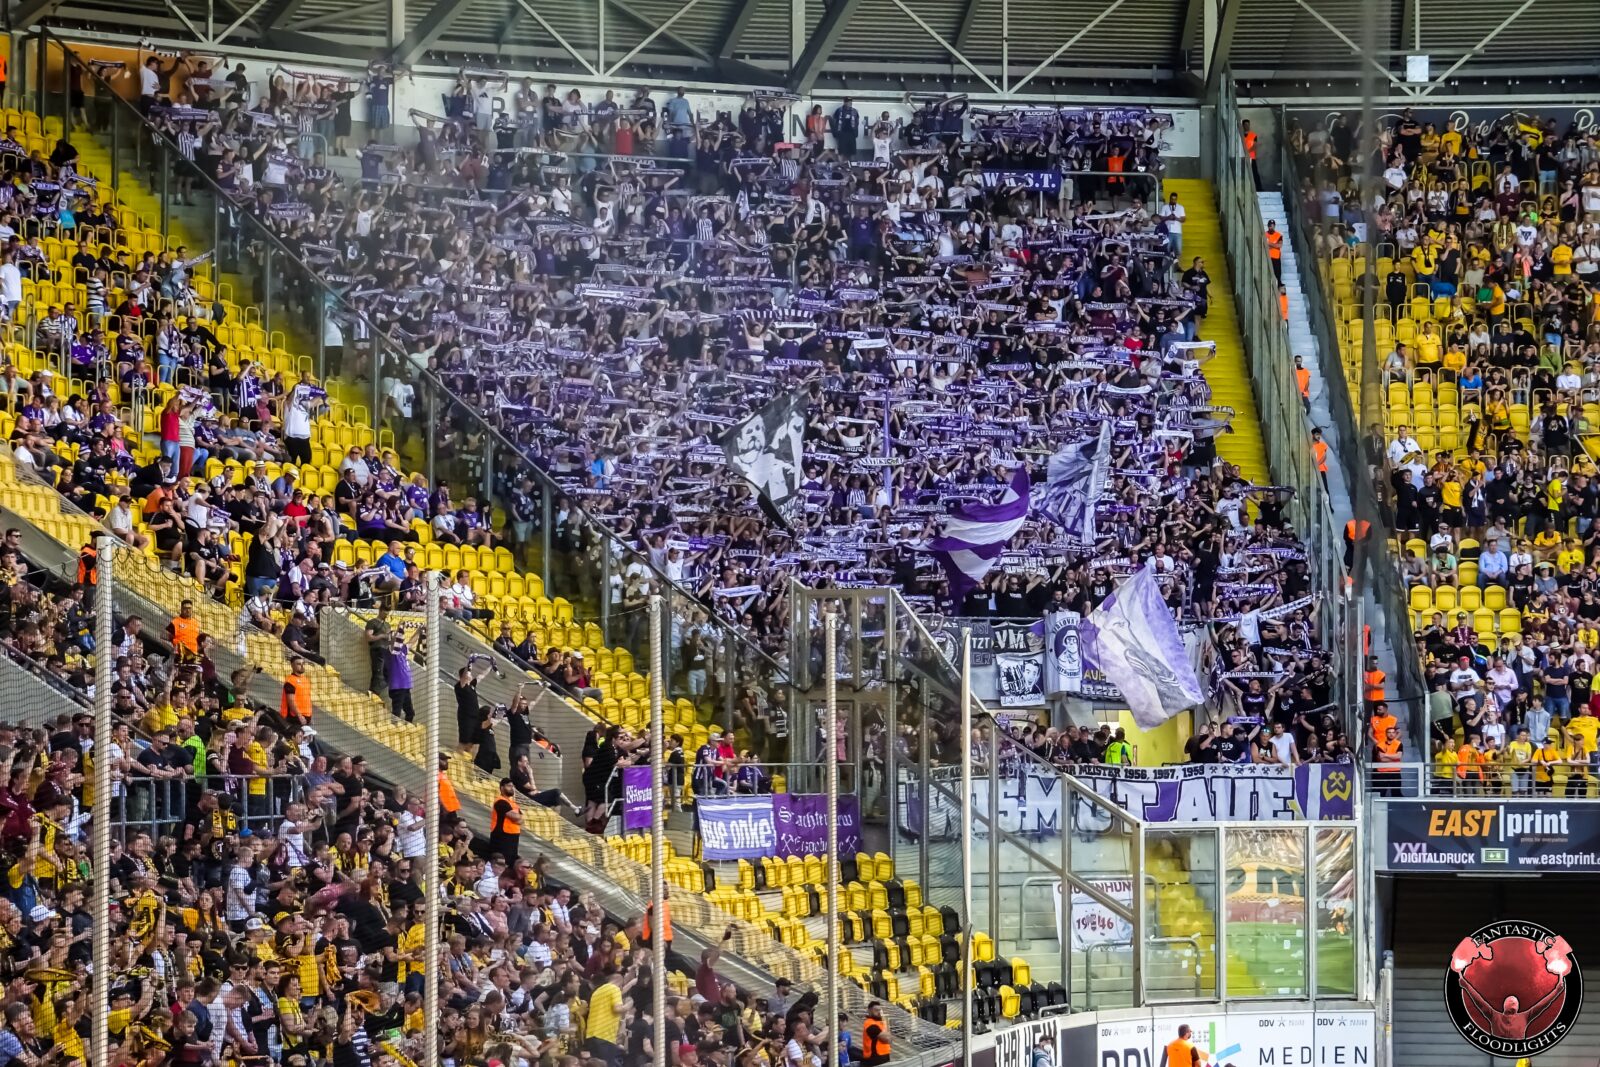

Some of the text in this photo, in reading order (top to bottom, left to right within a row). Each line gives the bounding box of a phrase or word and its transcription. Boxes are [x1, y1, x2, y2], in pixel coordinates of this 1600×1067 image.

[1078, 766, 1121, 778] MEISTER
[1427, 809, 1569, 837] EAST print
[1400, 852, 1475, 864] DIGITALDRUCK
[1317, 1018, 1335, 1026] DDV
[1259, 1045, 1368, 1066] MEDIEN
